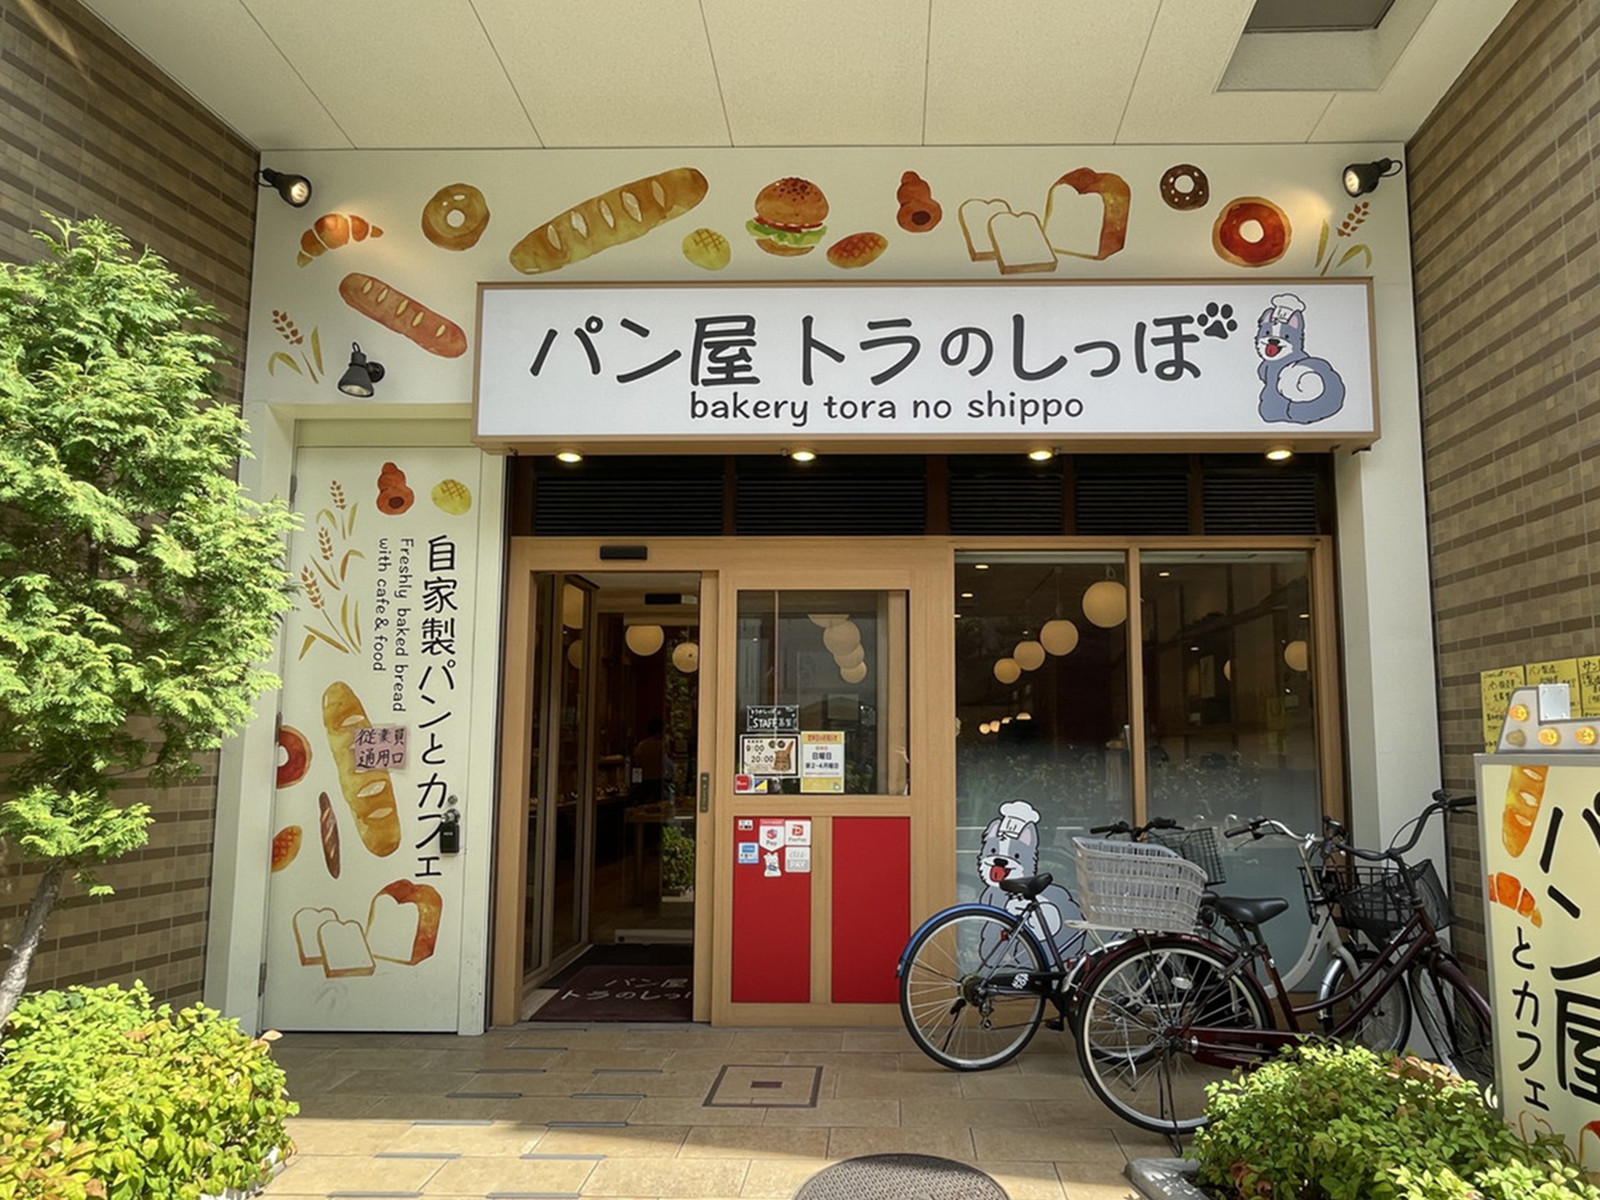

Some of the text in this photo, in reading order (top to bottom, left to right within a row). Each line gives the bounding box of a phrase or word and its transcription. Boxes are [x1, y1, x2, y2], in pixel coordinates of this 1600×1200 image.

[530, 303, 1237, 387] パン屋 トラのしっぽ
[691, 389, 1083, 427] bakery tora no shippo
[377, 538, 391, 572] with
[393, 538, 414, 712] Freshly baked bread
[373, 635, 389, 671] food
[414, 534, 458, 878] 自家製パンとカフェ
[357, 748, 404, 769] 通用口
[560, 989, 692, 1001] トラのしっ
[1511, 926, 1550, 1112] とカフェ
